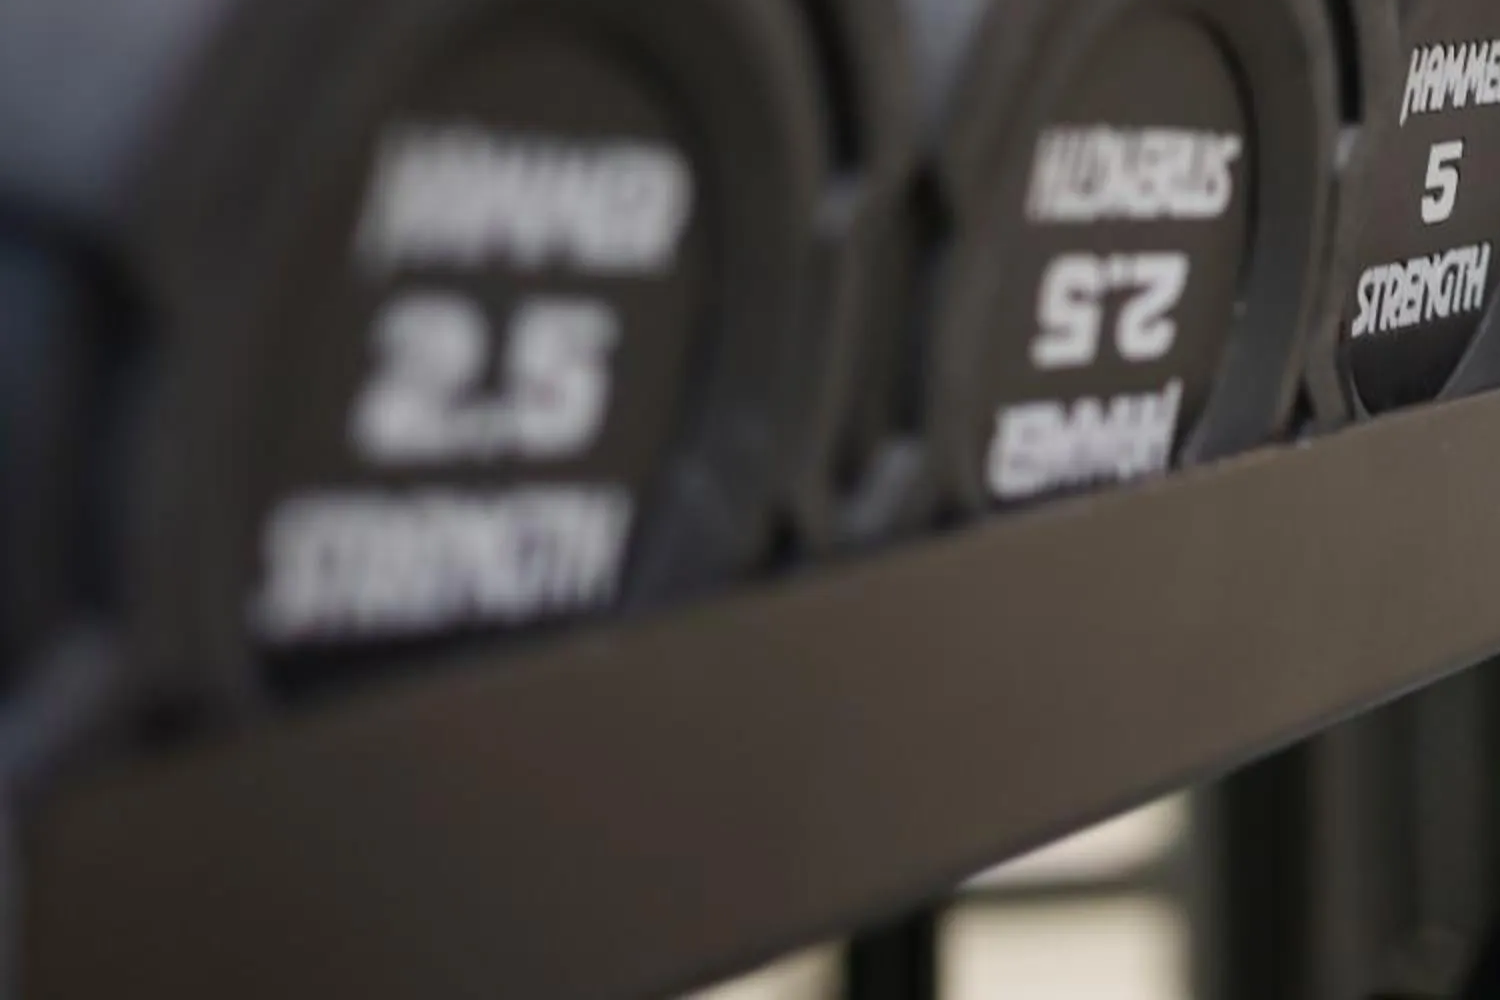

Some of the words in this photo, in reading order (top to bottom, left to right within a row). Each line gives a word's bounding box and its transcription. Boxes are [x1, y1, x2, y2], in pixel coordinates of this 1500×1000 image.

[1421, 140, 1463, 224] 5
[1030, 251, 1190, 370] 2.5
[1351, 242, 1491, 338] STRENGTH
[350, 290, 618, 463] 2.5
